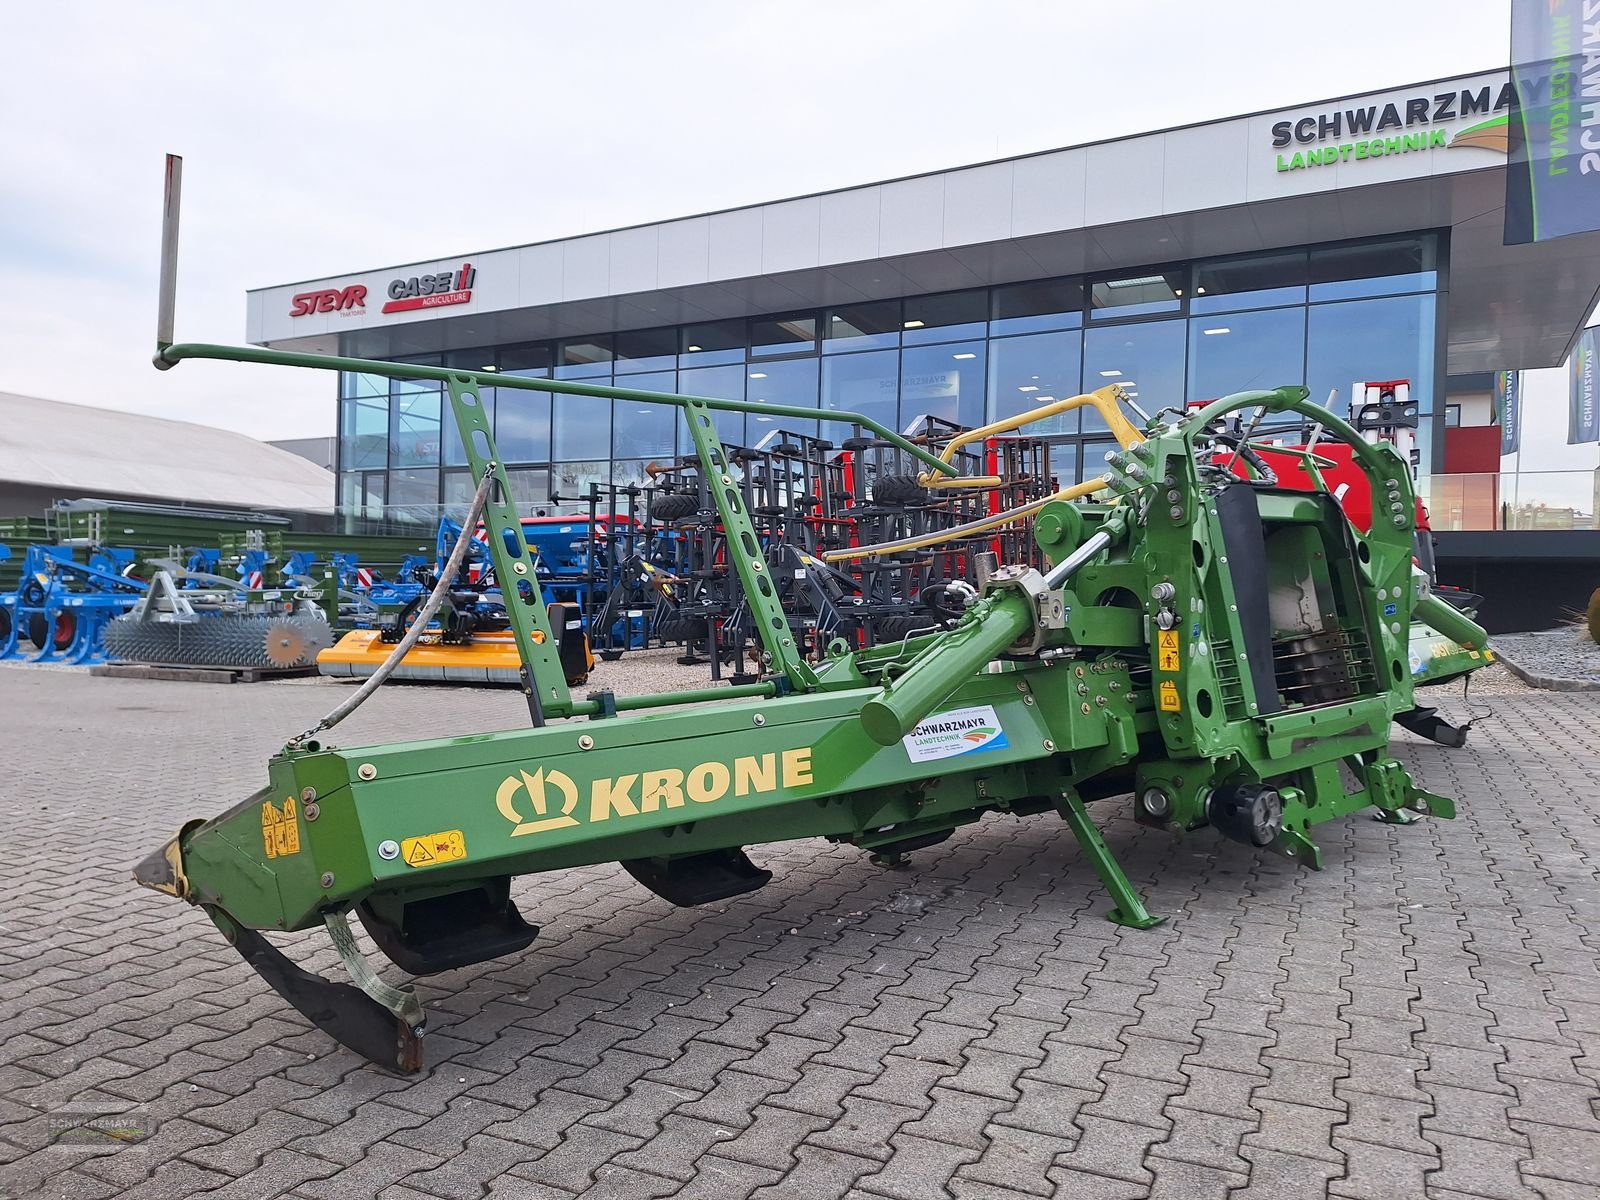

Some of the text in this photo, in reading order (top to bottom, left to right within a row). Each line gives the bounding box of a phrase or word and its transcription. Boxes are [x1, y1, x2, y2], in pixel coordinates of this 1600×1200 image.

[1276, 129, 1448, 172] LANDTECHNIK
[387, 272, 453, 300] CASE
[422, 293, 466, 306] AGRICULTURE
[289, 284, 368, 317] STEYR
[880, 375, 946, 389] SCHARZMAYR
[914, 733, 961, 746] LANDTECHNIK
[589, 747, 814, 823] KRONE
